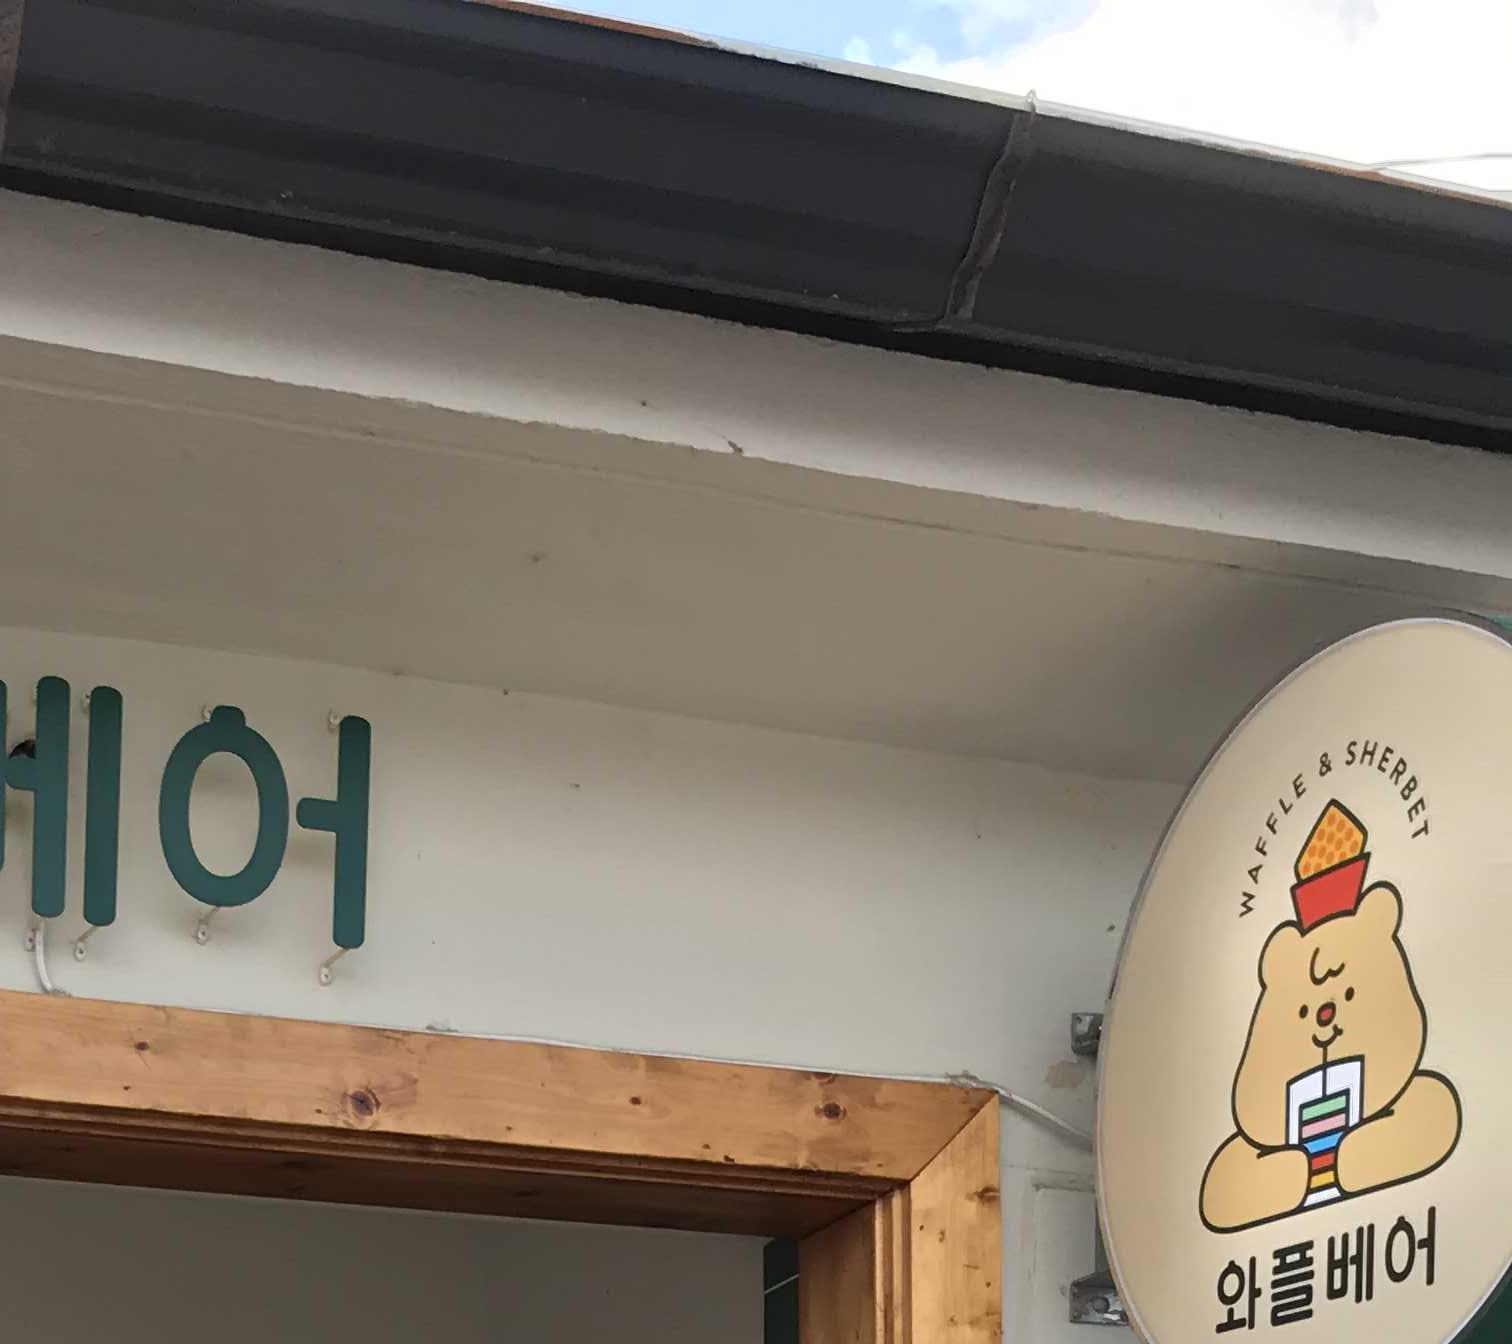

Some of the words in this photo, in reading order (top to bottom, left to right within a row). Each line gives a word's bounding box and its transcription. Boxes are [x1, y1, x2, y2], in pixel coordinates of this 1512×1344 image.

[1239, 773, 1307, 918] WAFFLE
[1318, 752, 1332, 777] &
[1345, 740, 1429, 839] SHERBET
[1216, 1206, 1436, 1334] 와플베어
